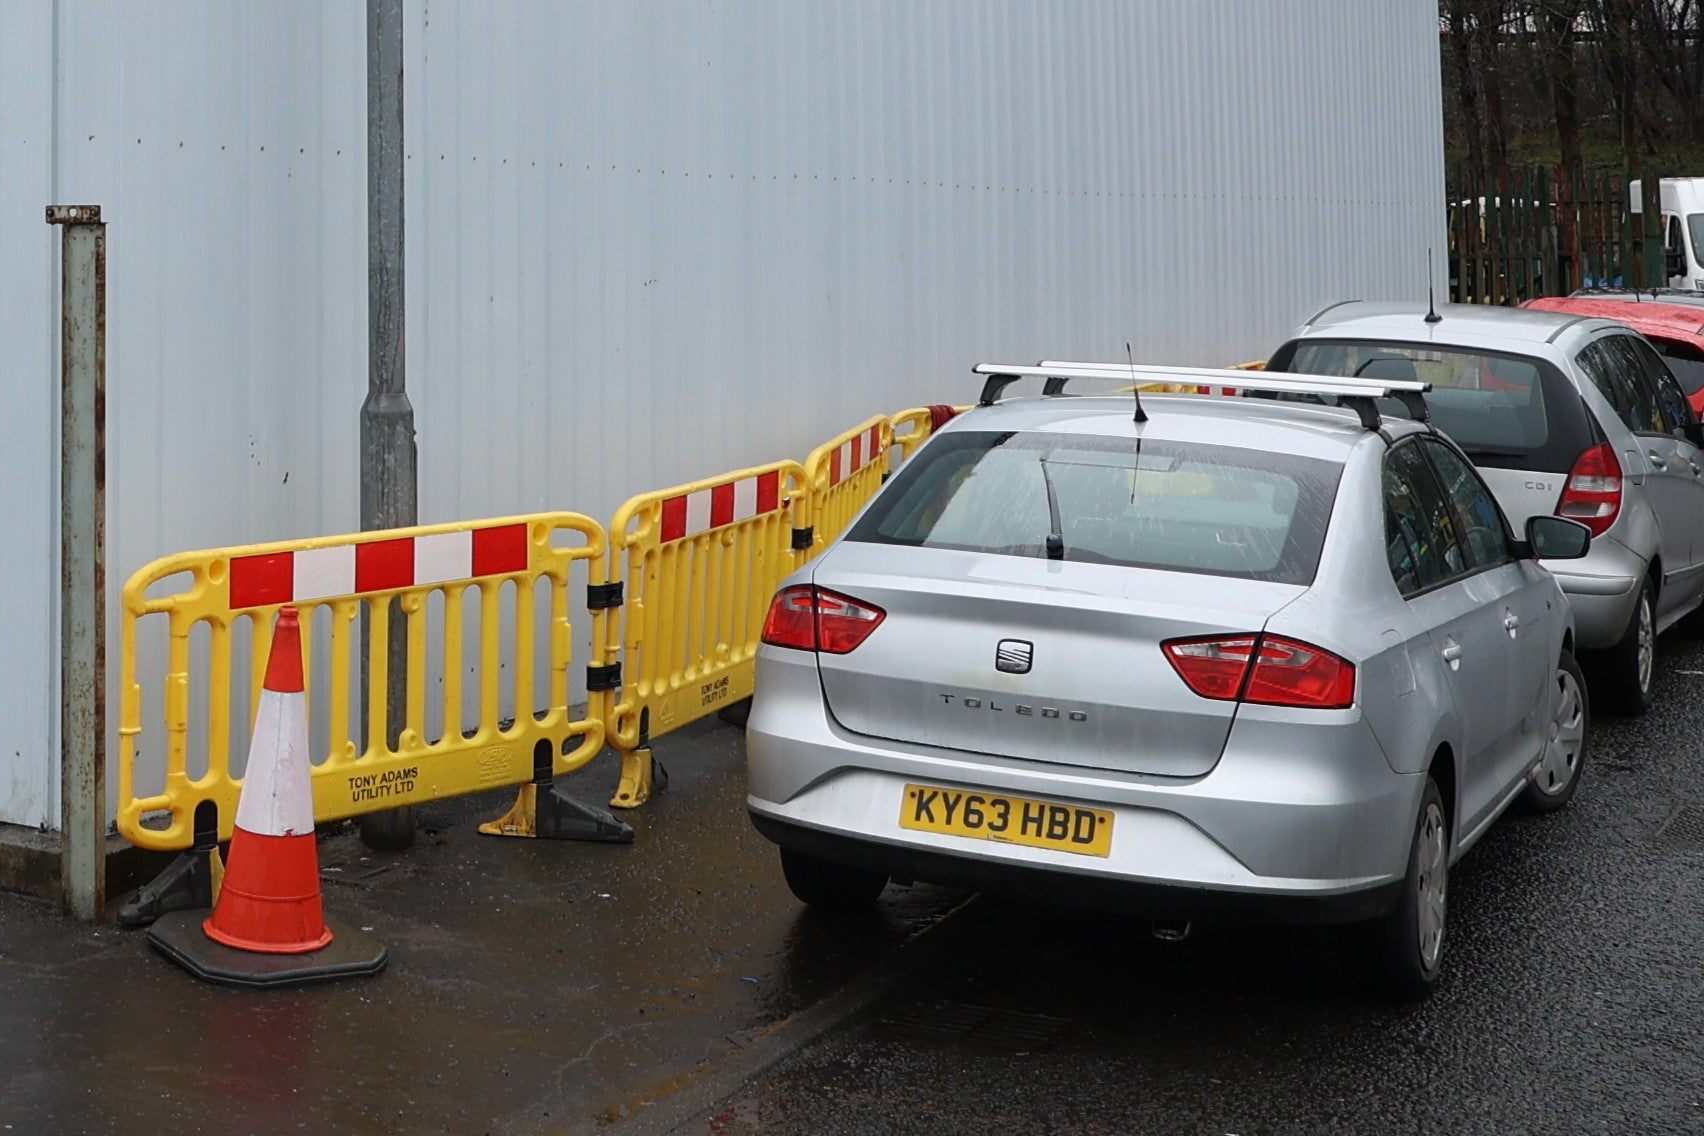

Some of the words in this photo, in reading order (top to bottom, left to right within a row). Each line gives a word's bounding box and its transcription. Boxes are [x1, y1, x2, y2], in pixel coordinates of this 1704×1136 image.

[939, 693, 1087, 722] TOLEDO
[348, 775, 378, 790] TONY
[380, 767, 419, 783] ADAMS
[352, 785, 395, 802] UTILITY
[395, 780, 415, 795] LTD
[914, 789, 1011, 833] KY63
[1020, 802, 1097, 845] HBD
